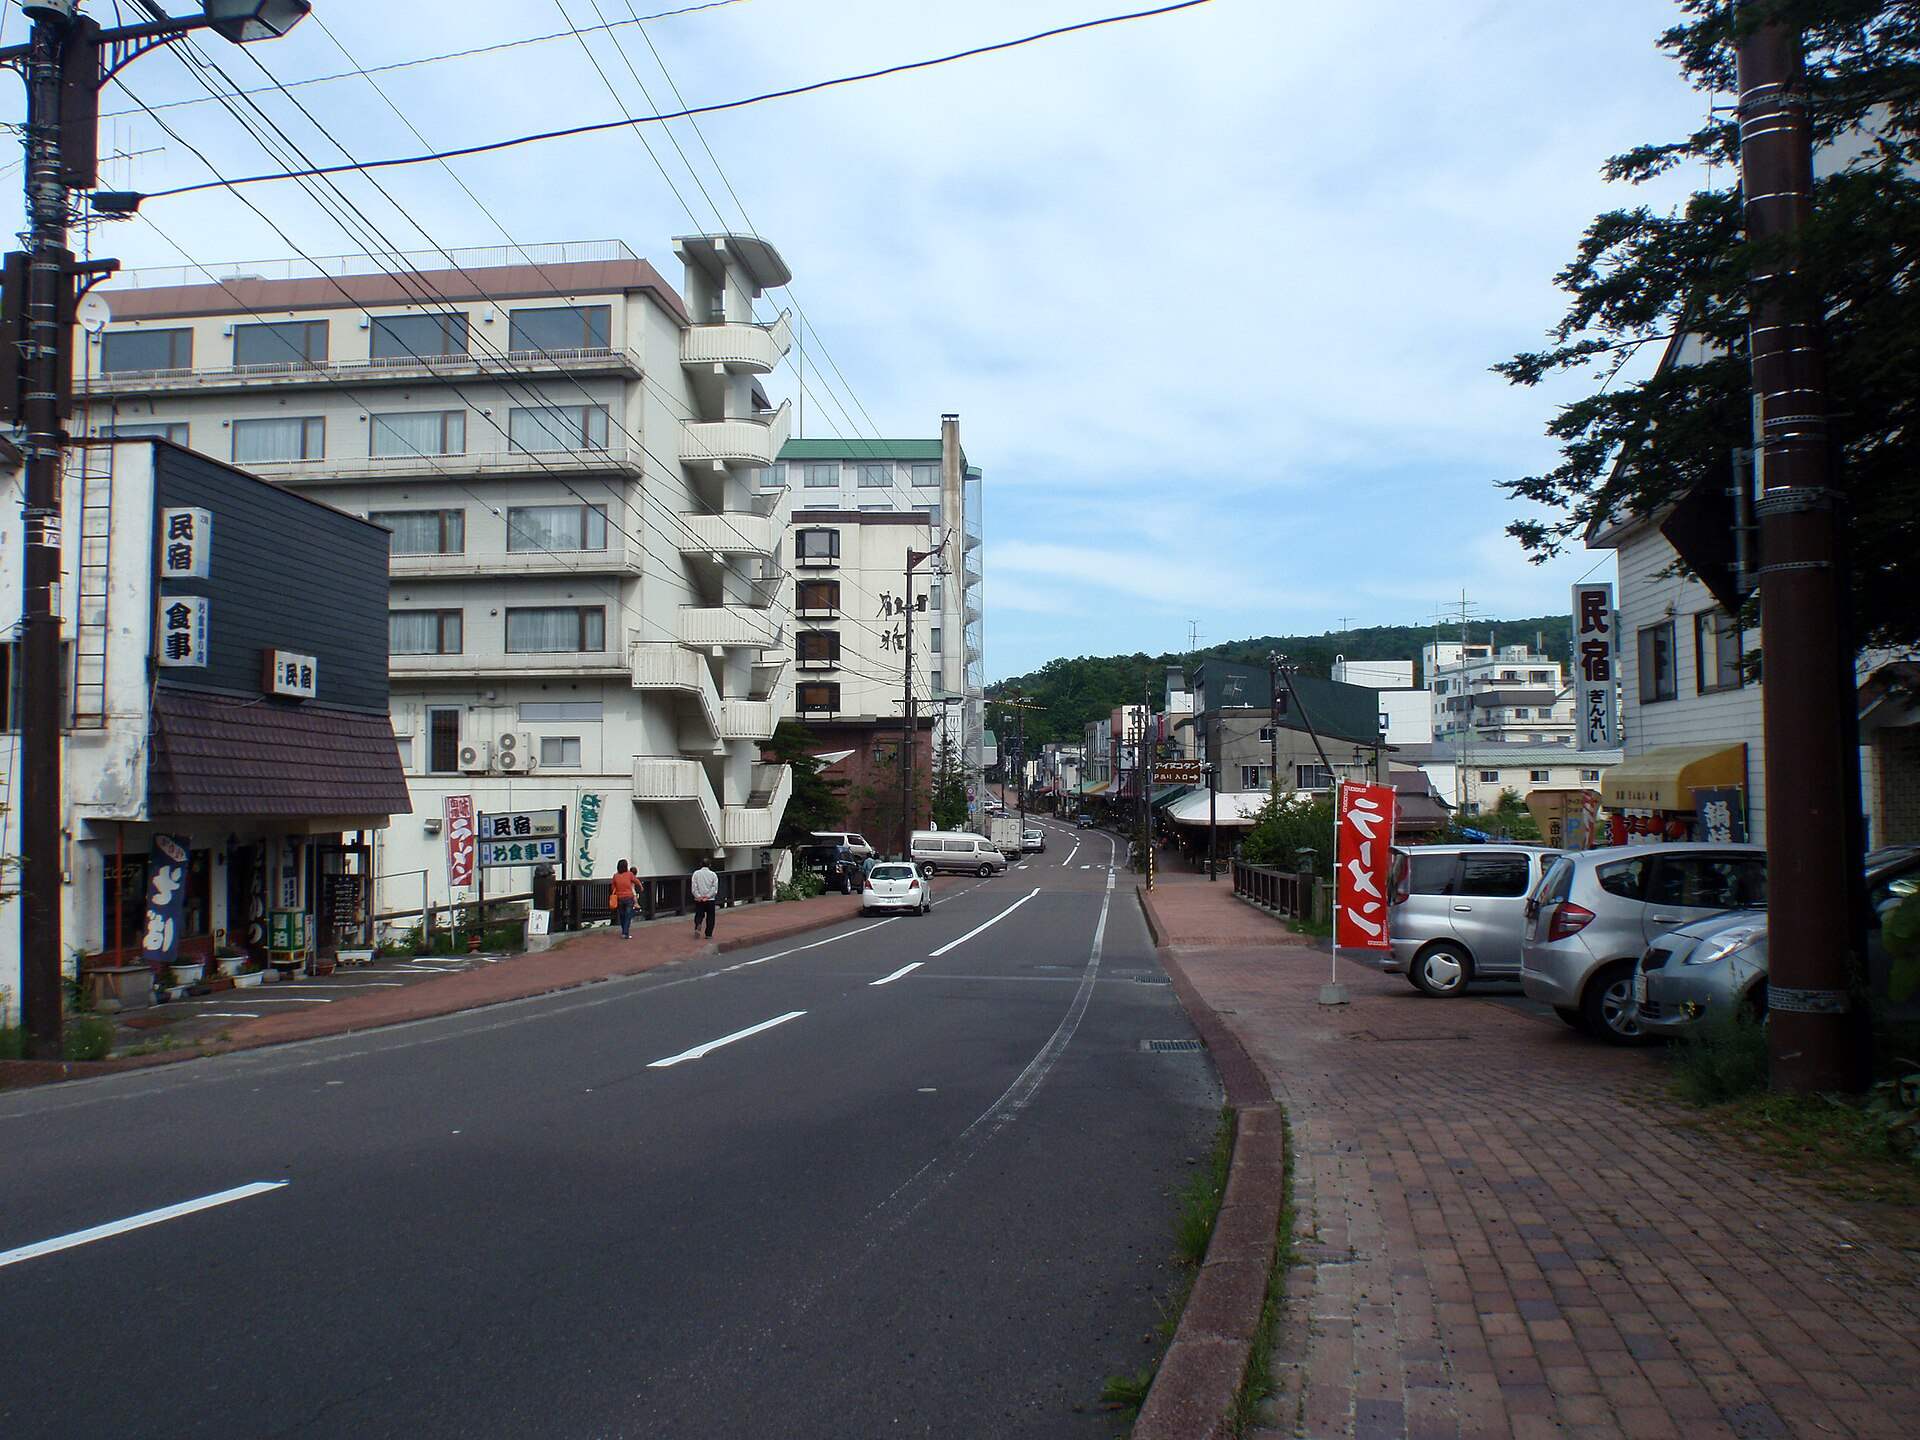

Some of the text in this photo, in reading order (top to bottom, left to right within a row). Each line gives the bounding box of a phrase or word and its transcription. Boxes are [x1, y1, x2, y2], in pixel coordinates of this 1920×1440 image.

[168, 513, 193, 570] 民宿
[165, 602, 191, 660] 食事
[1580, 591, 1609, 681] 民宿
[286, 663, 312, 689] 民宿
[450, 818, 472, 886] ラーメン
[493, 815, 531, 836] 民宿
[493, 843, 538, 861] お食事
